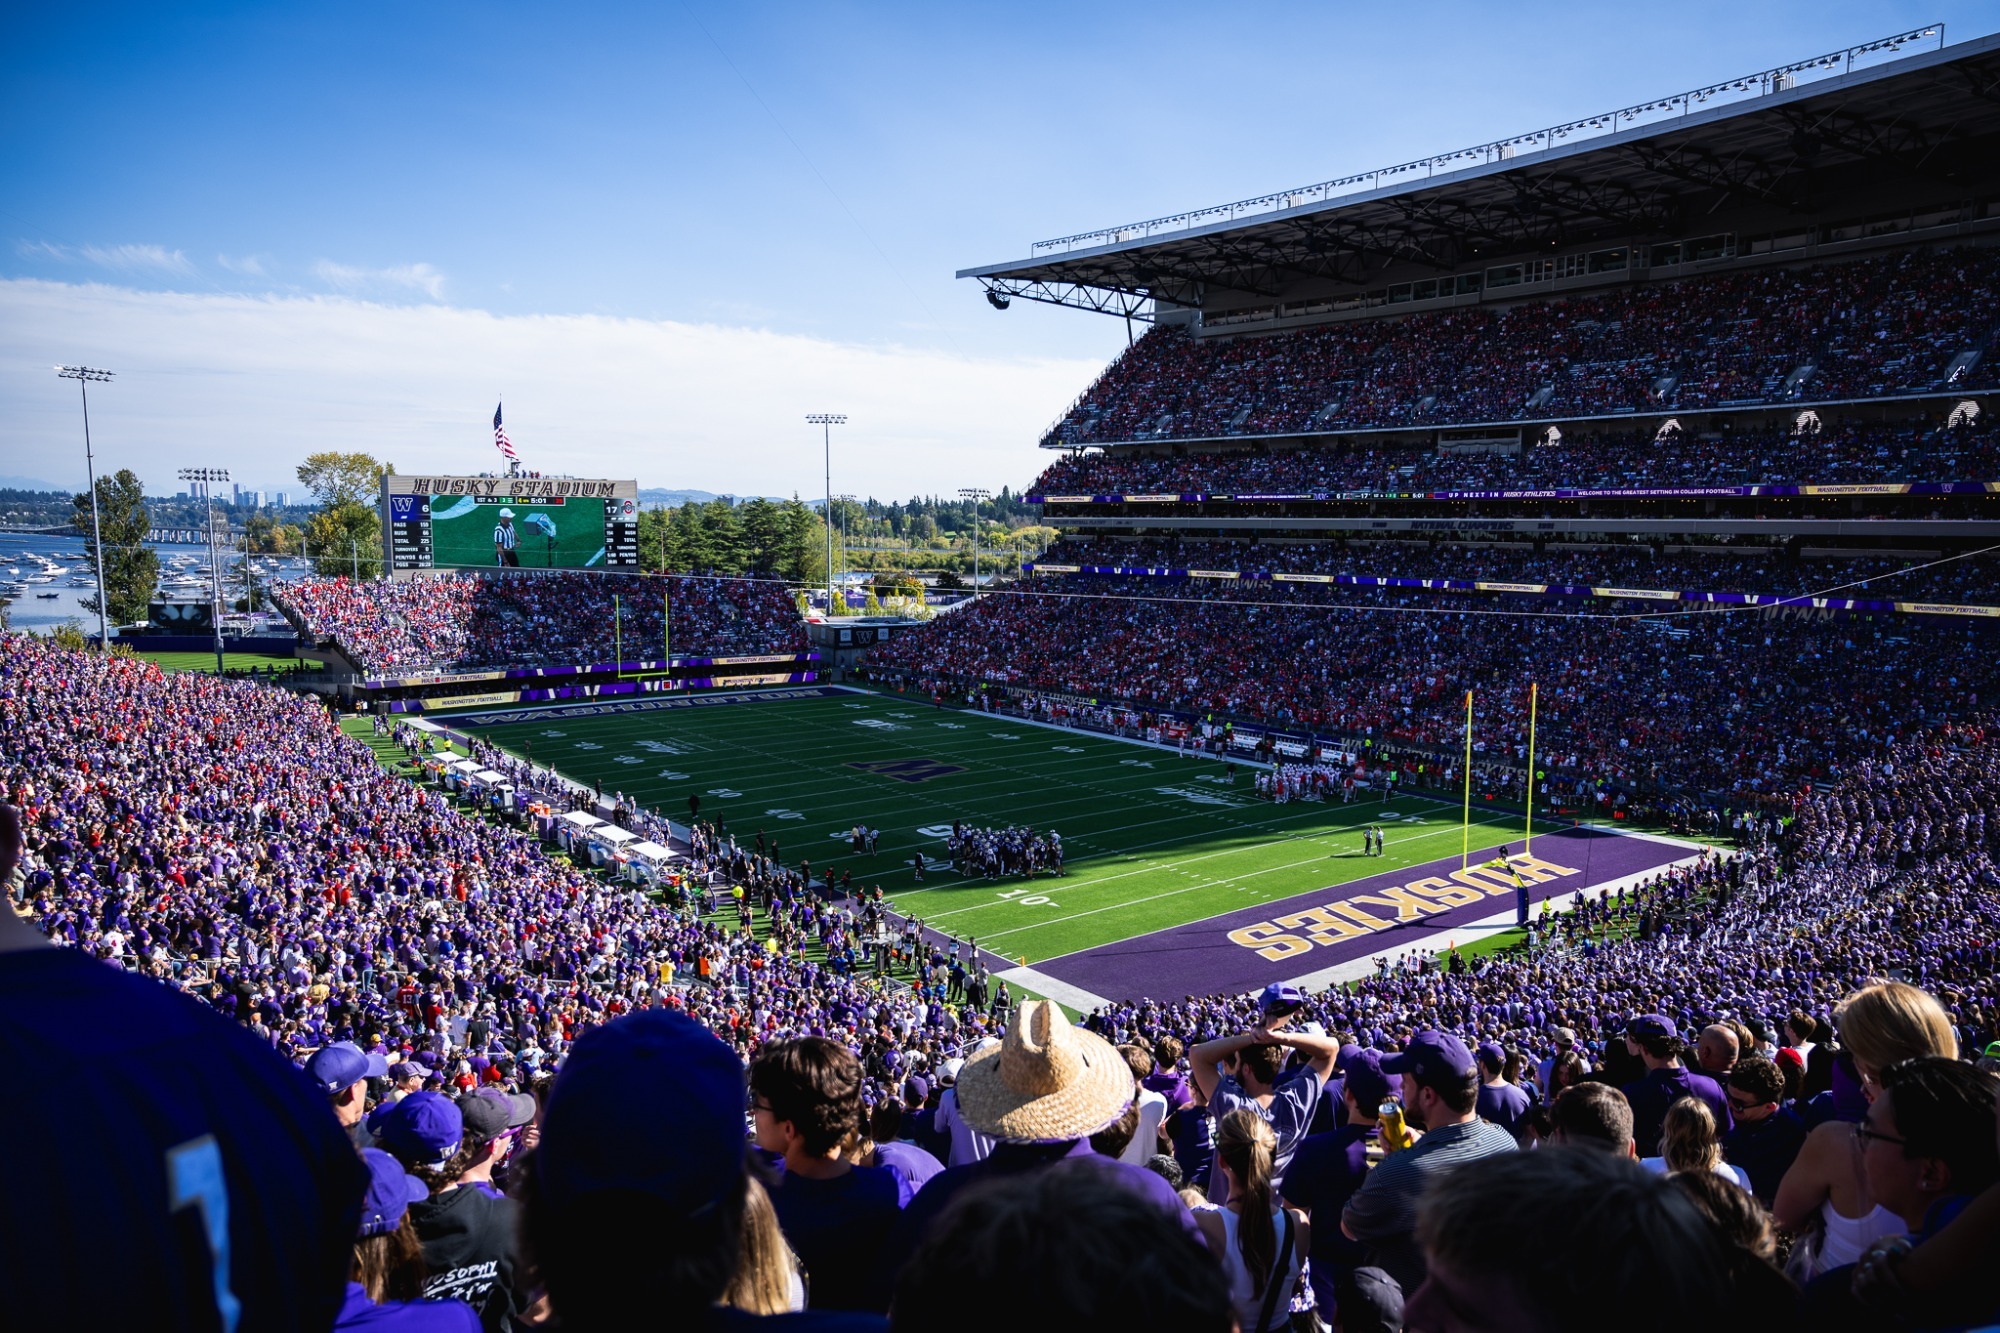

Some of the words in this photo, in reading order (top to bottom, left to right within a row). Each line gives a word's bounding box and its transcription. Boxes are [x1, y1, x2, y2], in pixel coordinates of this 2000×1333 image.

[412, 478, 499, 495] HUSKY
[510, 480, 616, 497] STADIUM
[392, 498, 413, 512] W
[422, 504, 429, 513] 6
[606, 506, 618, 514] 17
[1410, 521, 1455, 530] NATIONAL
[1457, 521, 1515, 530] CHAMPIONS
[1955, 606, 1989, 614] FOOTBALL
[465, 689, 824, 724] WASHINGTON
[996, 889, 1051, 906] 10
[1226, 855, 1582, 962] HUSKIES
